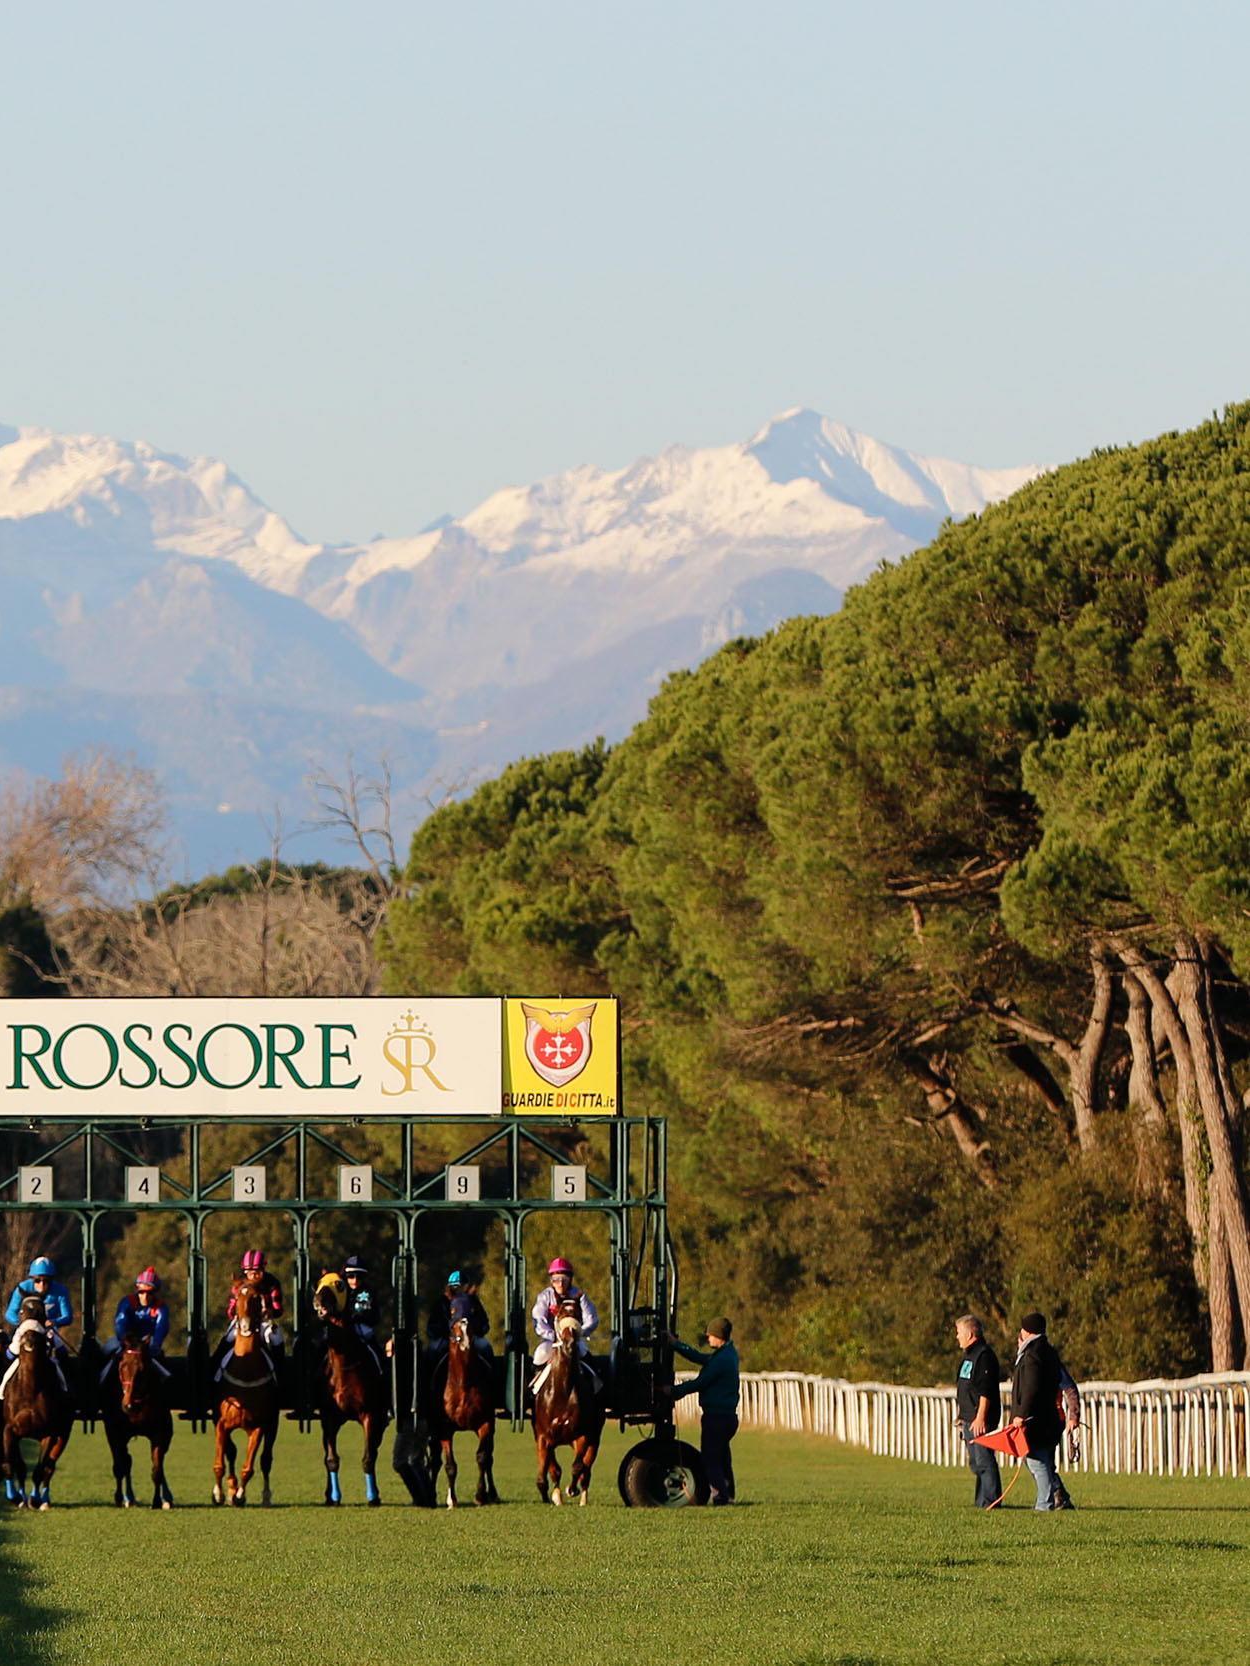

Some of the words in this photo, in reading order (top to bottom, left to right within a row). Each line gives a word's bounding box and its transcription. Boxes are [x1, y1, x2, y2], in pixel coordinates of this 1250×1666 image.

[5, 1023, 362, 1090] ROSSORE
[31, 1177, 42, 1195] 2
[138, 1177, 149, 1195] 4
[244, 1177, 255, 1194] 3
[351, 1177, 361, 1194] 6
[457, 1176, 468, 1194] 9
[564, 1176, 575, 1194] 5
